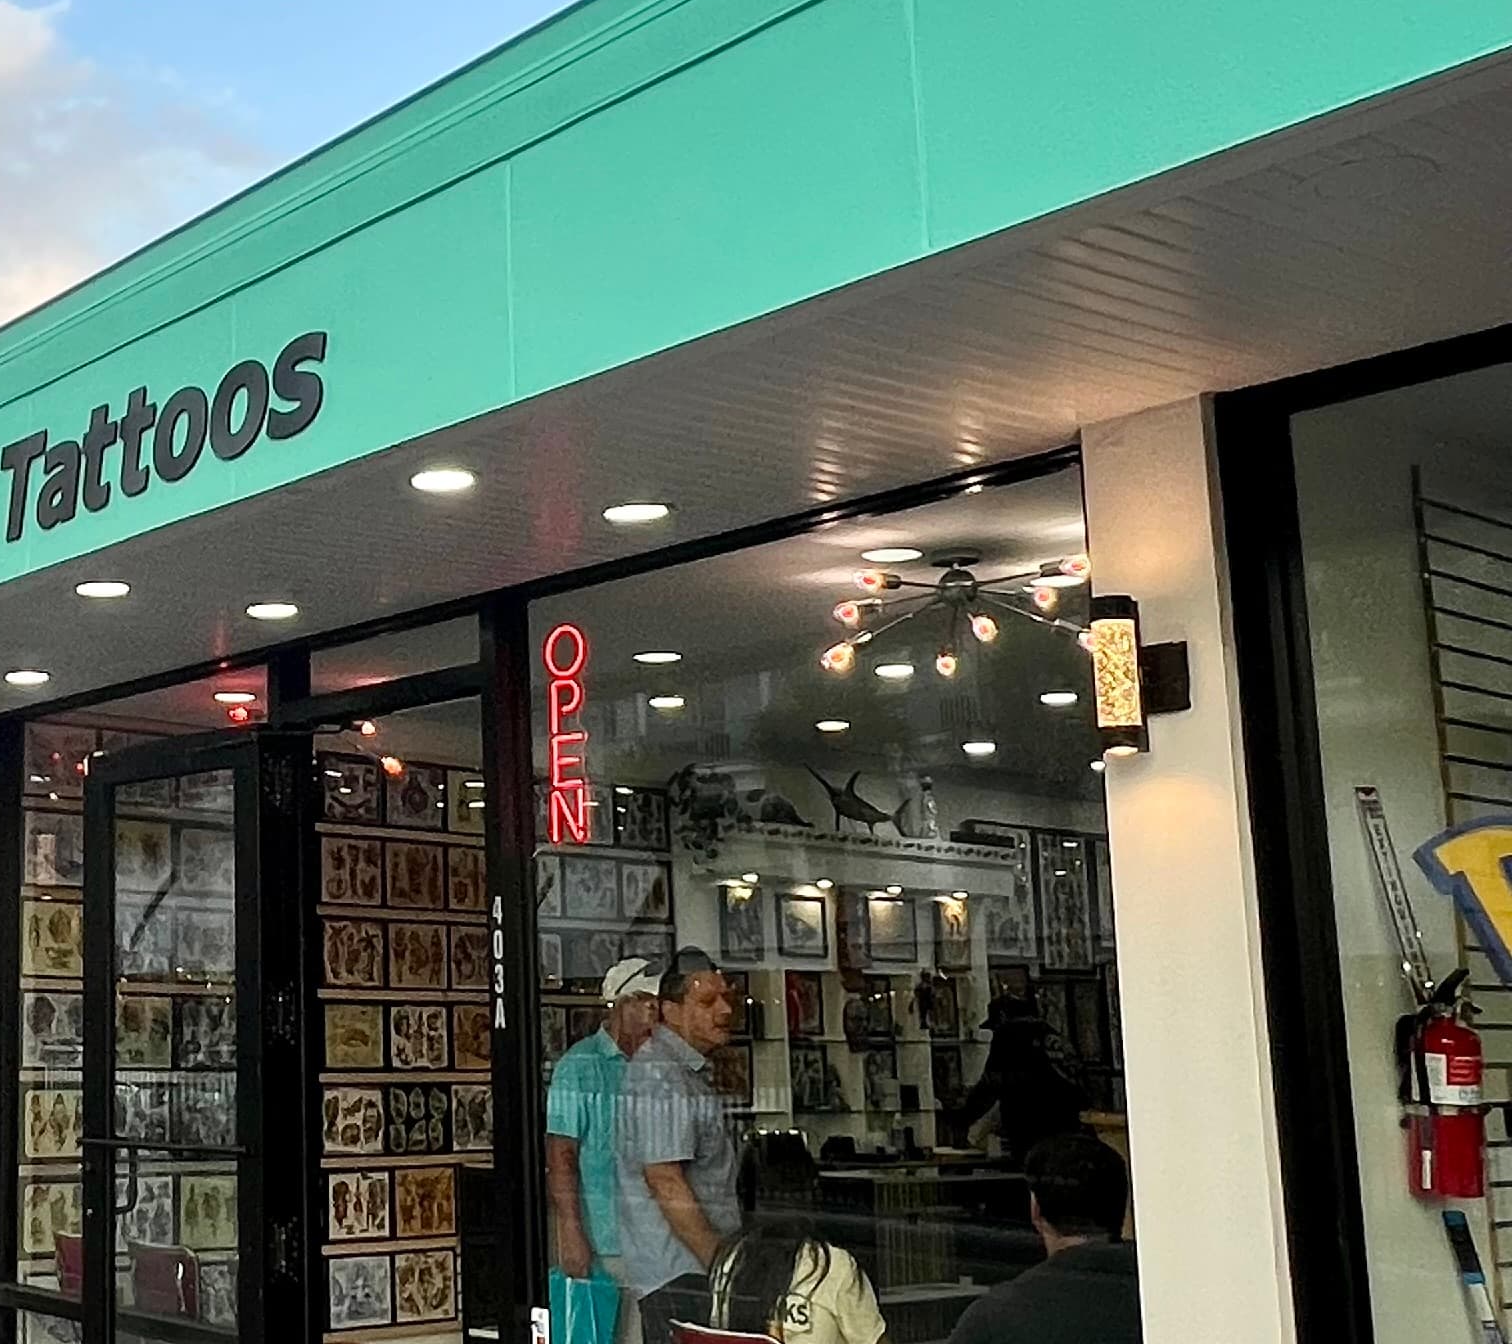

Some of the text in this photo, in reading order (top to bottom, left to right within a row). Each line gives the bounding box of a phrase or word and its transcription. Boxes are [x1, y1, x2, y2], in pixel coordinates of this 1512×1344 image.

[0, 331, 328, 543] Tattoos
[543, 623, 587, 843] OPEN
[492, 895, 506, 1029] 403A
